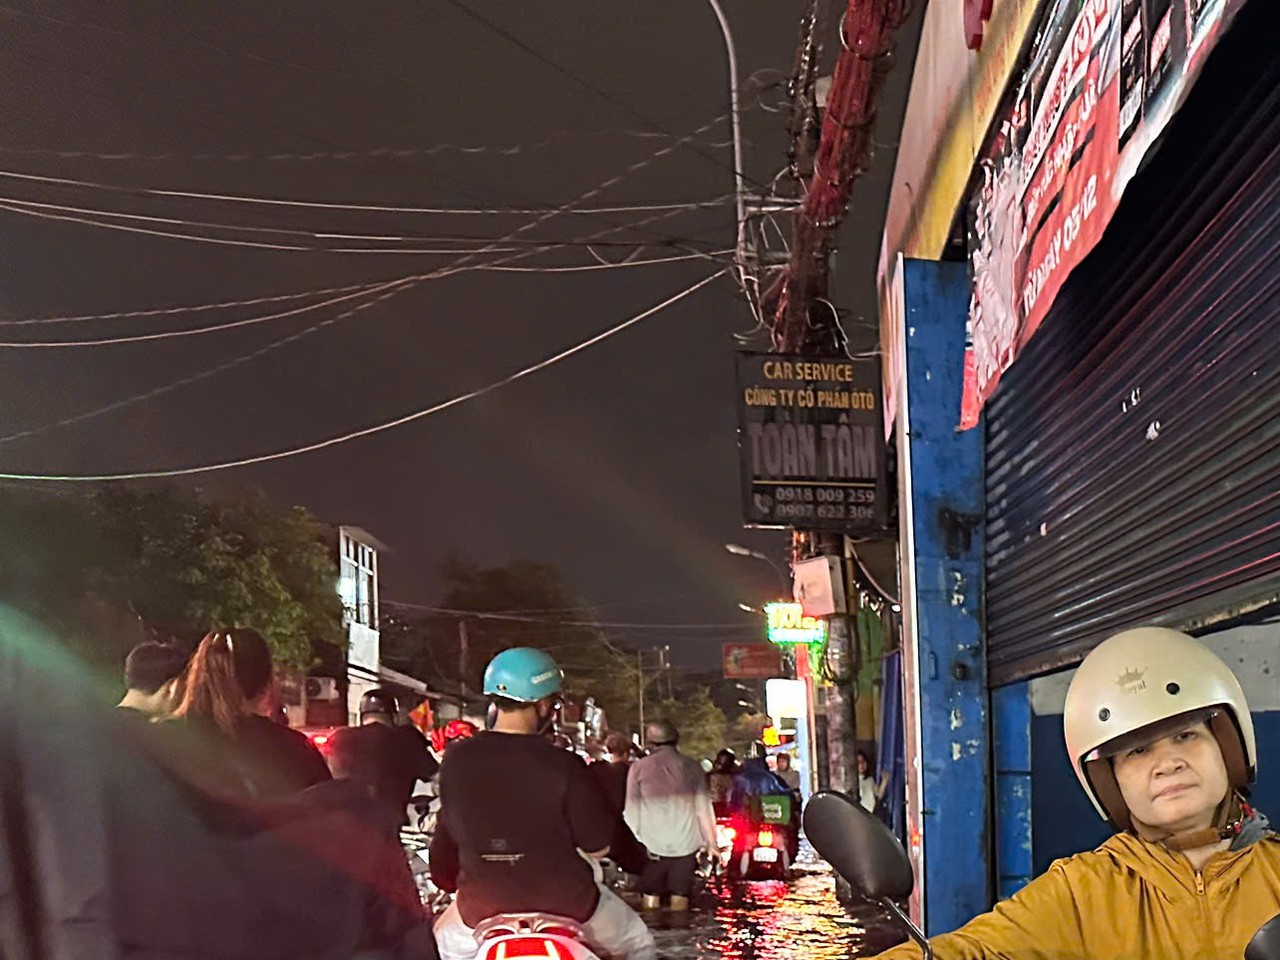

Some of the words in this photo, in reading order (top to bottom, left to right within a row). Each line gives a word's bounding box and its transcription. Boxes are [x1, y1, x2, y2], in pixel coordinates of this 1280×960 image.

[763, 361, 792, 379] CAR
[796, 362, 853, 381] SERVICE
[745, 384, 777, 407] CÔNG
[779, 389, 794, 407] TY
[798, 384, 815, 408] CỔ
[747, 411, 815, 476] TOÀN
[821, 413, 877, 478] TÂM
[776, 487, 813, 501] 0918
[816, 488, 844, 502] 009
[848, 489, 875, 503] 259
